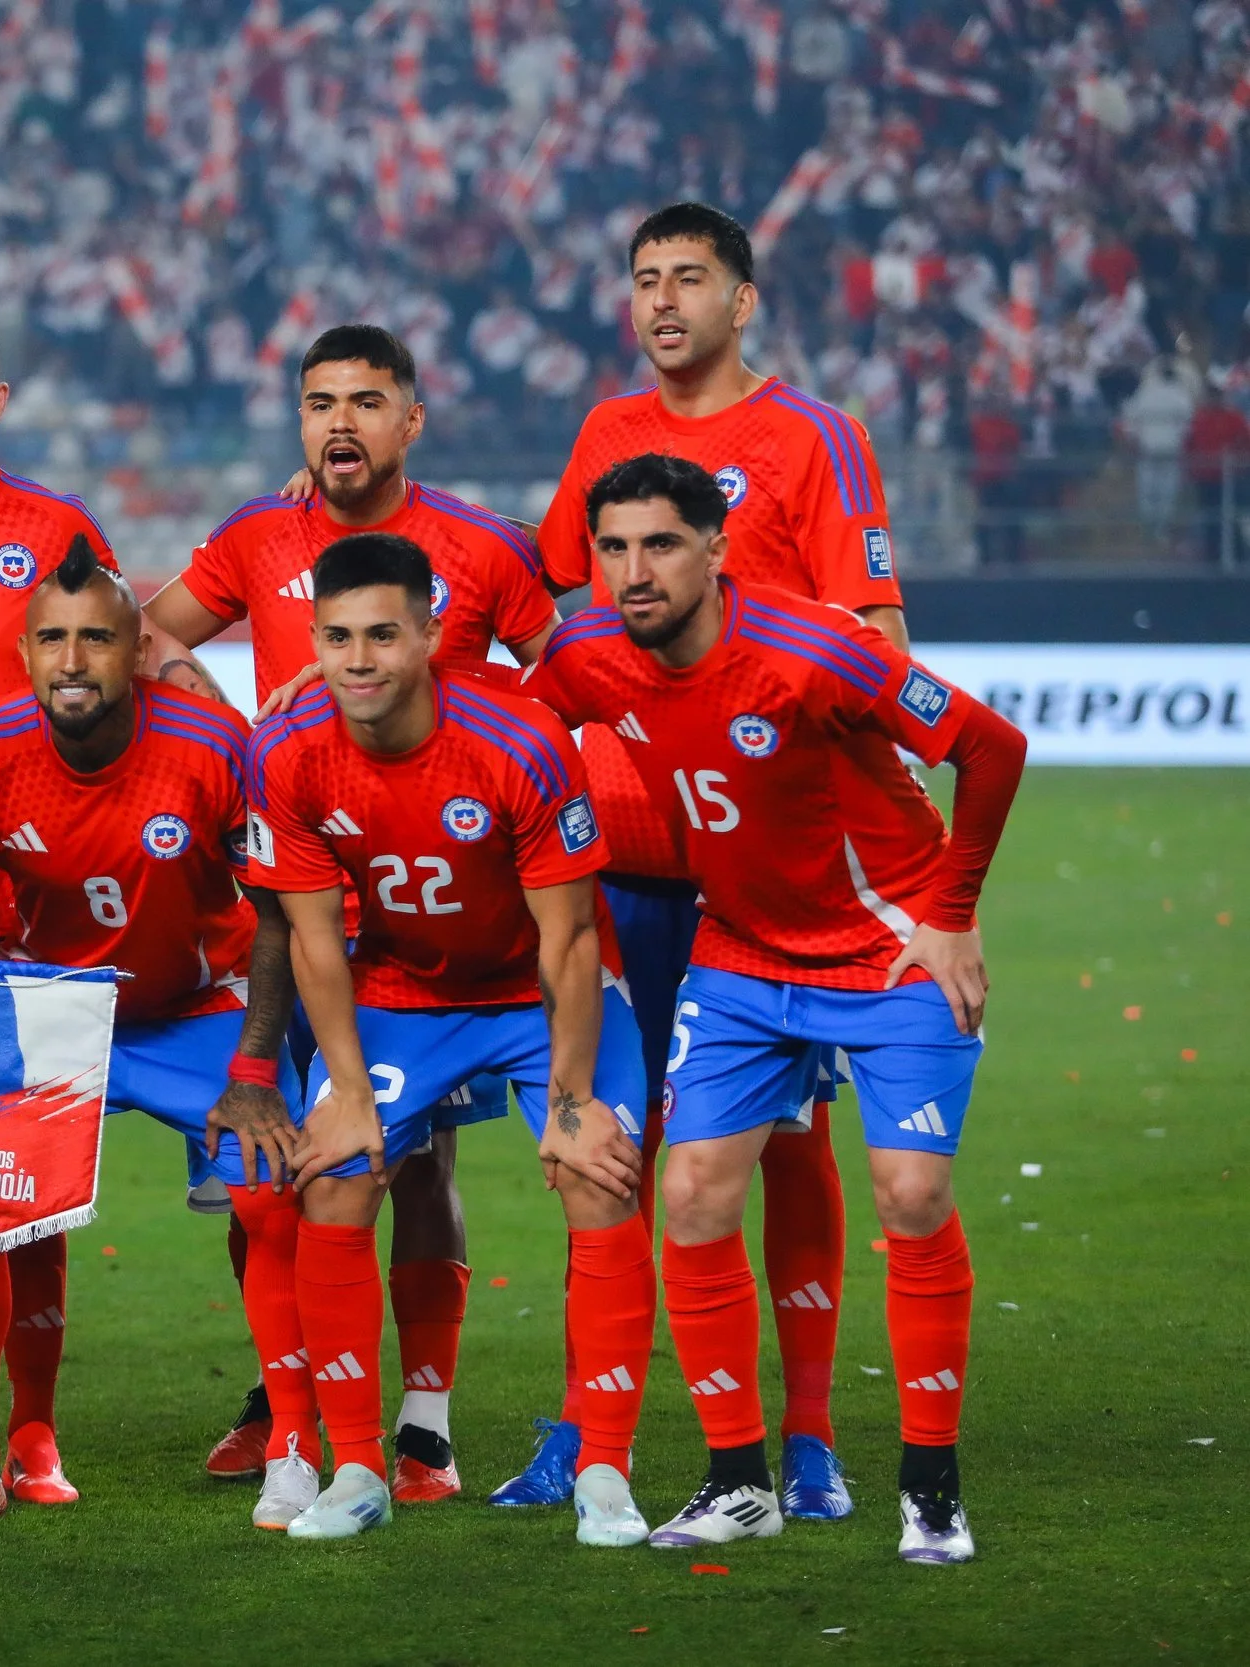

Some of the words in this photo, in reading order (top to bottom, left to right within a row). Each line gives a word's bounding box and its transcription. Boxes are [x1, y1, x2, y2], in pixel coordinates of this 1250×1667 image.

[982, 682, 1244, 729] REPSOL
[673, 769, 740, 832] 15
[84, 876, 128, 928] 8
[369, 854, 463, 915] 22
